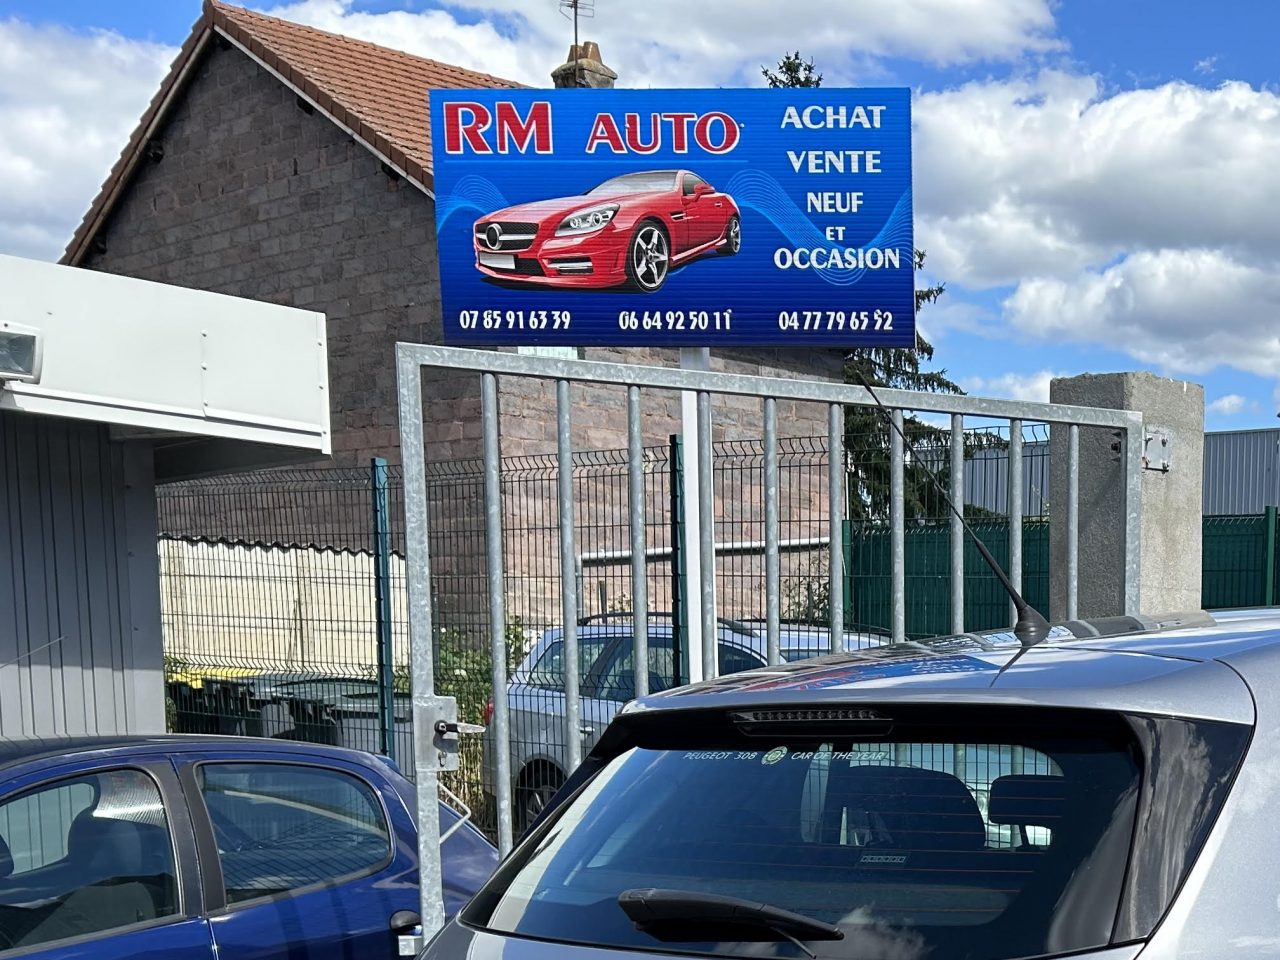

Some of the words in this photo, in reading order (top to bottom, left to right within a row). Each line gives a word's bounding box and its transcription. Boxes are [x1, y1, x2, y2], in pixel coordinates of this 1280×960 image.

[780, 105, 886, 129] ACHAT
[443, 101, 553, 155] RM
[585, 111, 741, 155] AUTO
[786, 150, 882, 174] VENTE
[806, 191, 864, 213] NEUF
[825, 225, 846, 242] ET
[773, 247, 900, 270] OCCASION
[459, 310, 479, 329] 07
[505, 310, 524, 329] 91
[528, 310, 548, 329] 63
[551, 310, 571, 330] 39
[642, 311, 663, 330] 64
[665, 311, 685, 330] 92
[688, 311, 709, 330] 50
[778, 311, 800, 330] 04
[802, 311, 822, 330] 77
[825, 311, 846, 330] 79
[849, 311, 869, 330] 65
[683, 751, 731, 761] PEUGEOT
[733, 751, 759, 761] 308
[790, 751, 813, 761] CAR
[814, 751, 831, 761] OF
[831, 751, 854, 761] THE
[854, 751, 886, 761] YEAR
